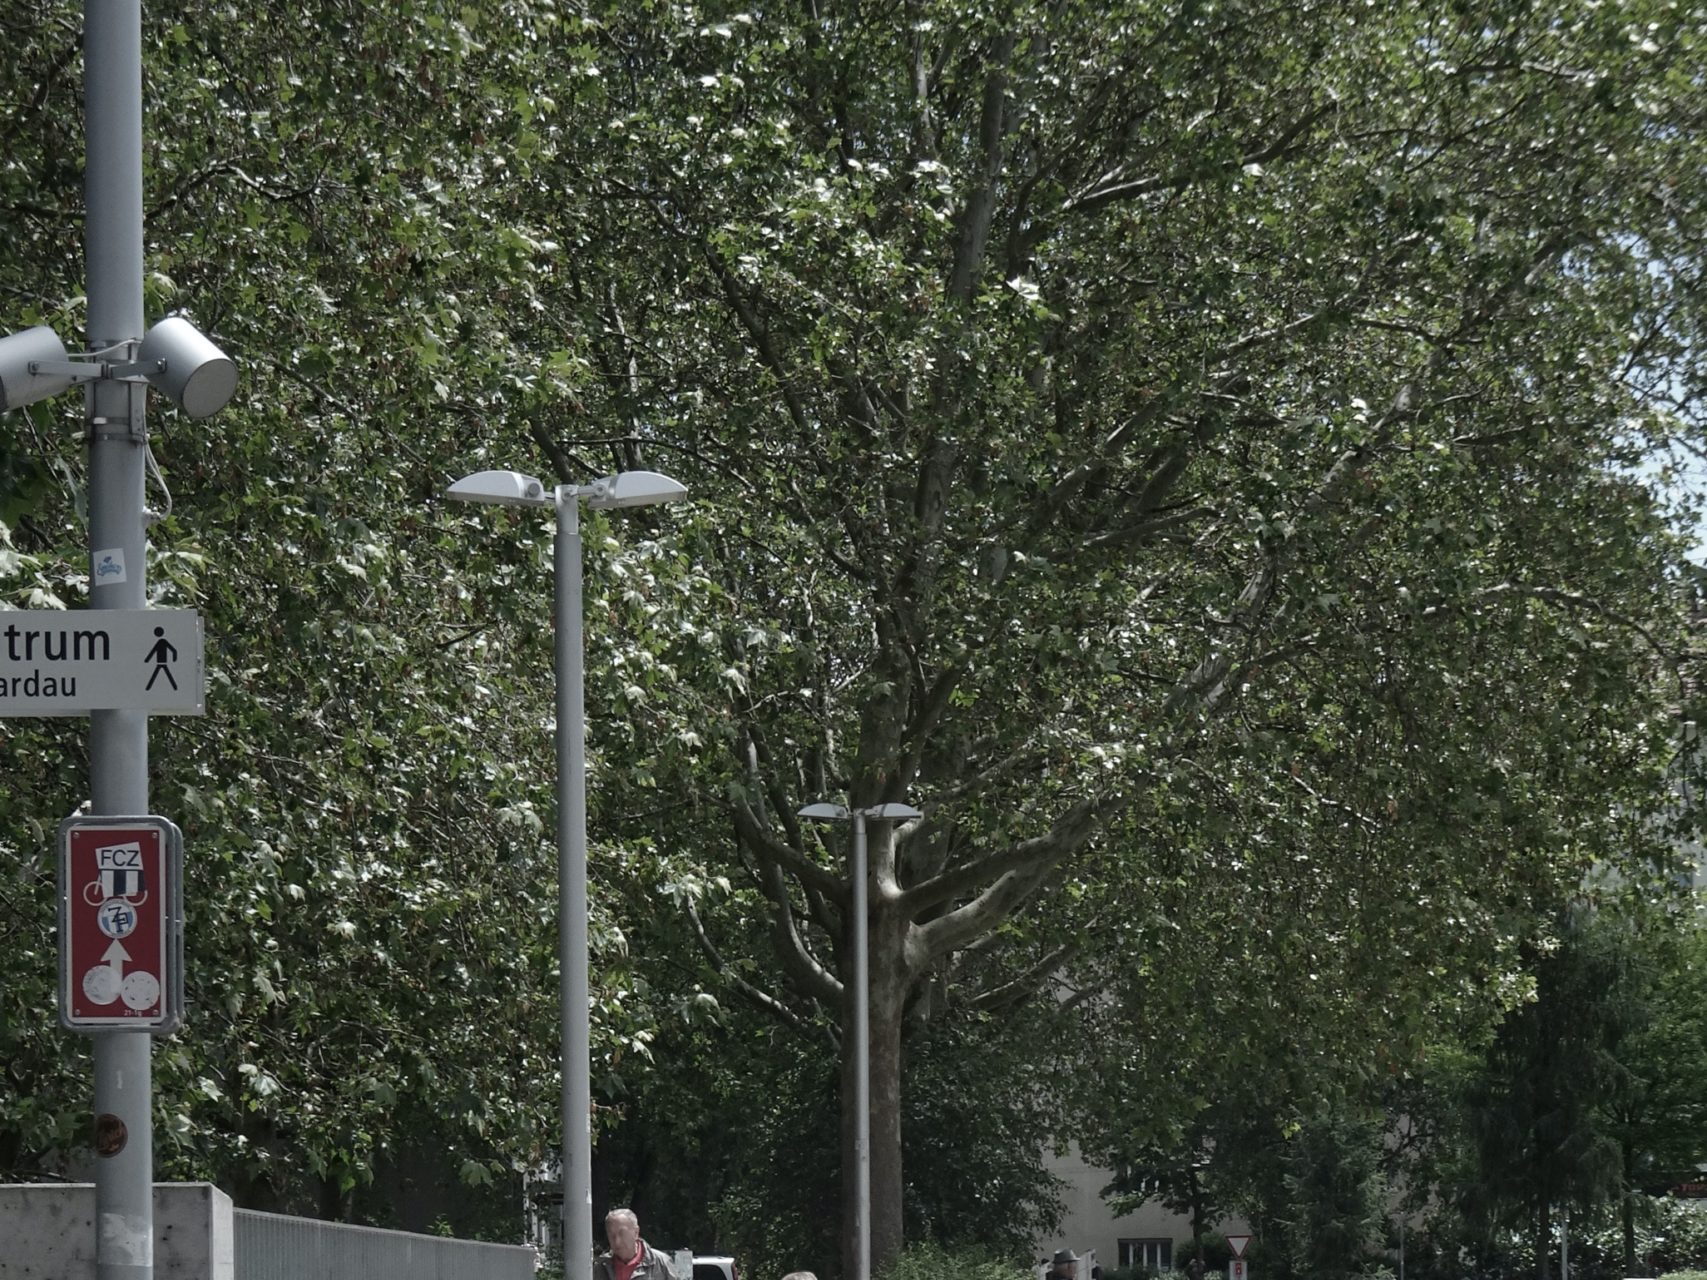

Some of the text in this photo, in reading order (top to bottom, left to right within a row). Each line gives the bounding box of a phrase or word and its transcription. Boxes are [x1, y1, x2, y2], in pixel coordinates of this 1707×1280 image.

[4, 624, 110, 661] trum
[0, 669, 76, 697] ardau
[101, 849, 139, 867] FCZ
